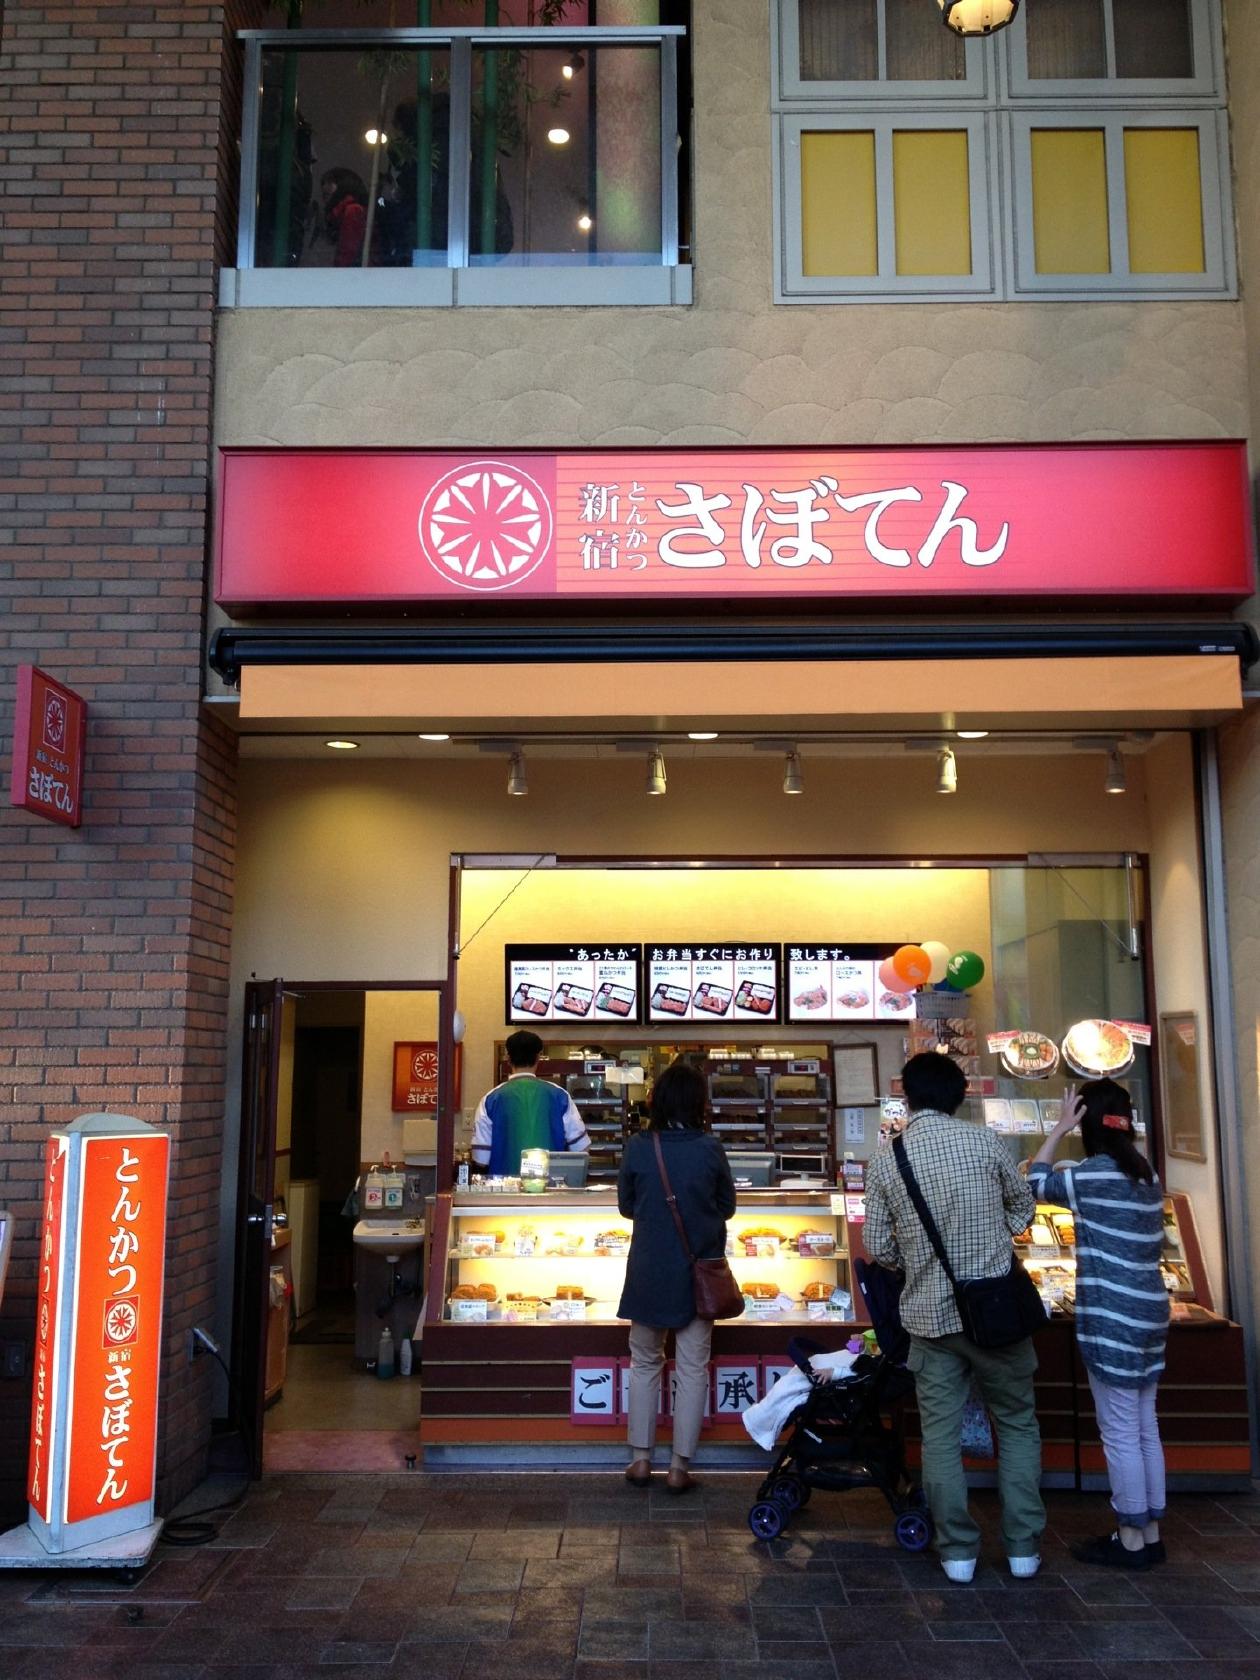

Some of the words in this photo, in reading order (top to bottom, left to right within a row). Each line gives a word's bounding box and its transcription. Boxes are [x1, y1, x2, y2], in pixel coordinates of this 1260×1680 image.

[578, 482, 620, 571] 新宿
[626, 480, 649, 571] とんかつ
[655, 475, 1010, 569] さぼてん
[28, 766, 74, 814] さぼてん
[652, 948, 773, 961] お弁当すぐにお作り
[790, 948, 851, 961] 致します。
[407, 1093, 438, 1105] さぼて
[108, 1147, 142, 1296] とんかつ
[97, 1365, 134, 1504] さぼてん
